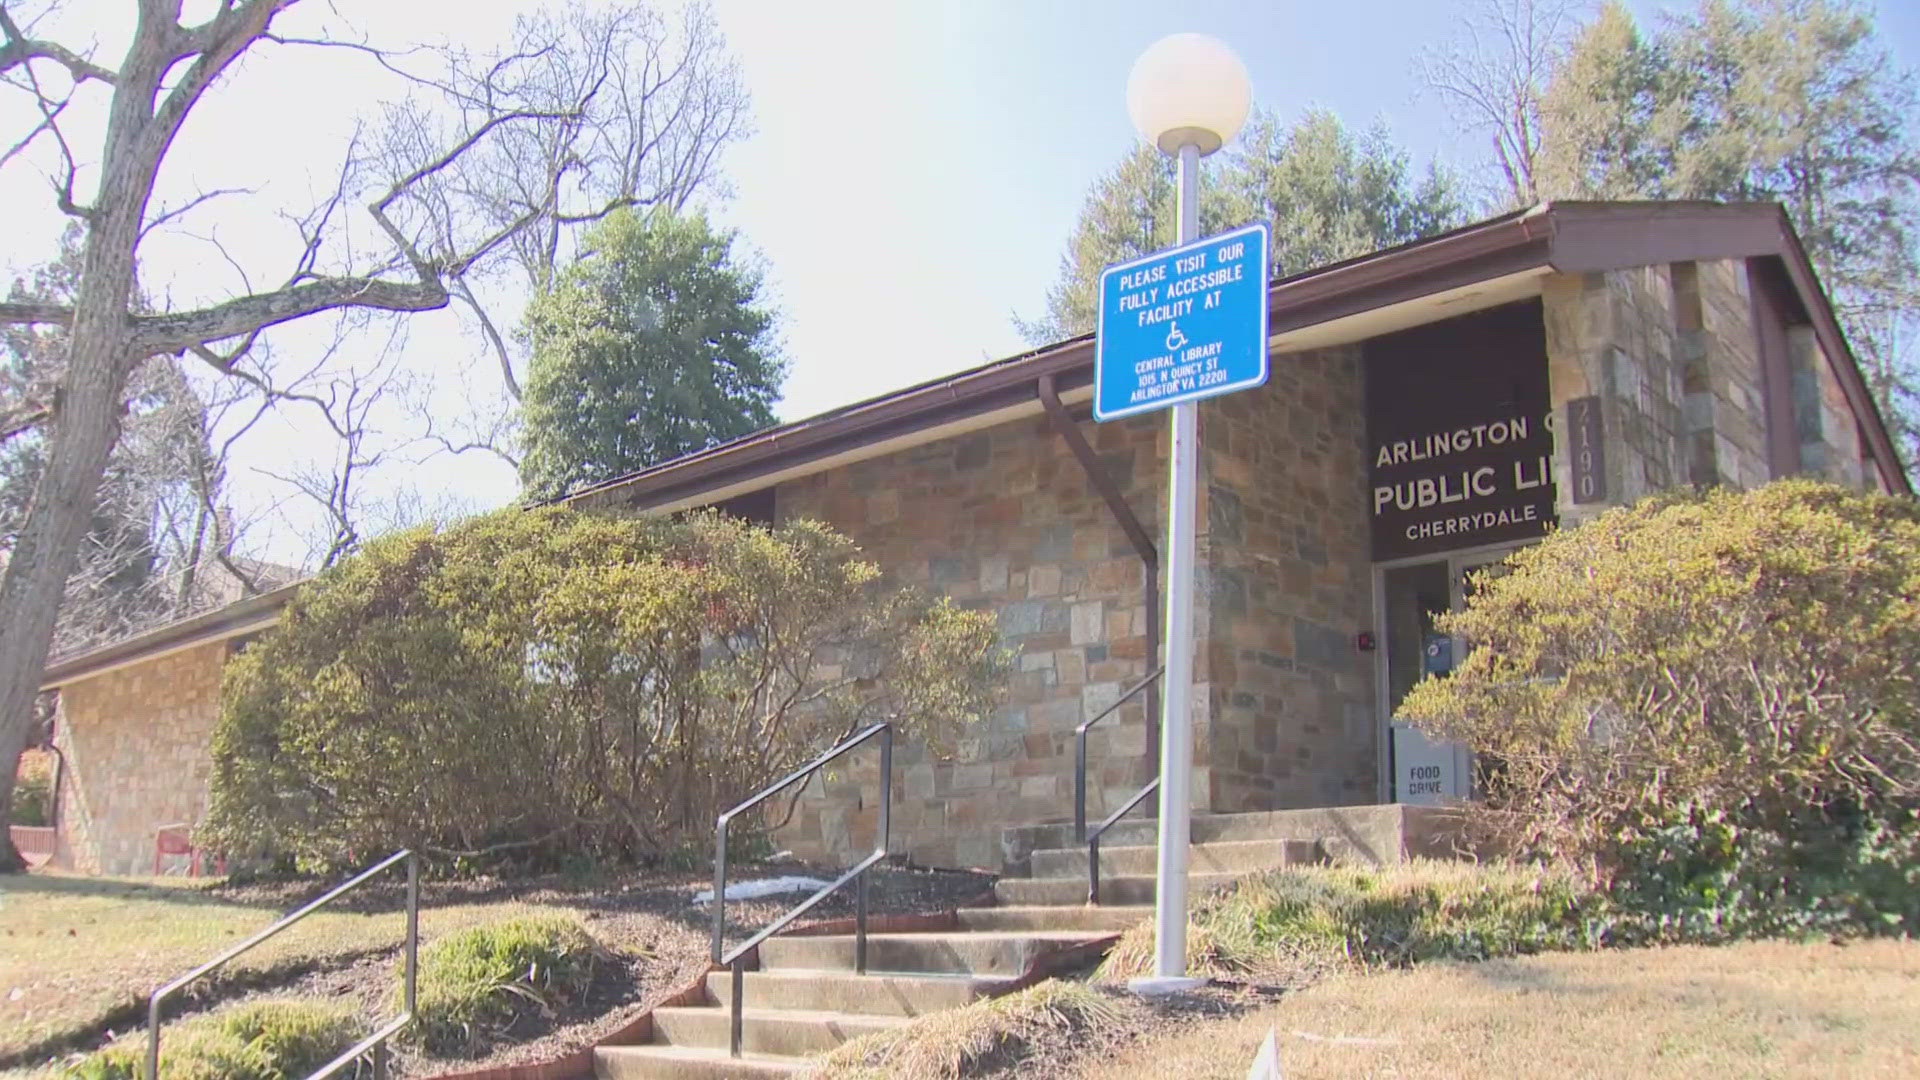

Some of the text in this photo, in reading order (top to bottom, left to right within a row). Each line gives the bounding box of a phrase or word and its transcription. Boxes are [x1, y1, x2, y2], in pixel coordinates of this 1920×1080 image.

[1120, 242, 1244, 291] PLEASE VISIT OUR
[1120, 264, 1243, 312] FULLY ACCESSIBLE
[1139, 291, 1222, 327] FACILITY AT
[1135, 341, 1222, 374] CENTRAL LIBRARY
[1139, 357, 1218, 388] 1015 N QUINCY ST
[1130, 368, 1227, 403] ARLINGTON VA 22201
[1376, 415, 1528, 469] ARLINGTON
[1374, 467, 1497, 516] PUBLIC
[1406, 504, 1537, 541] CHERRYDALE
[1409, 781, 1442, 795] DRIVE
[1410, 766, 1440, 780] FOOD
